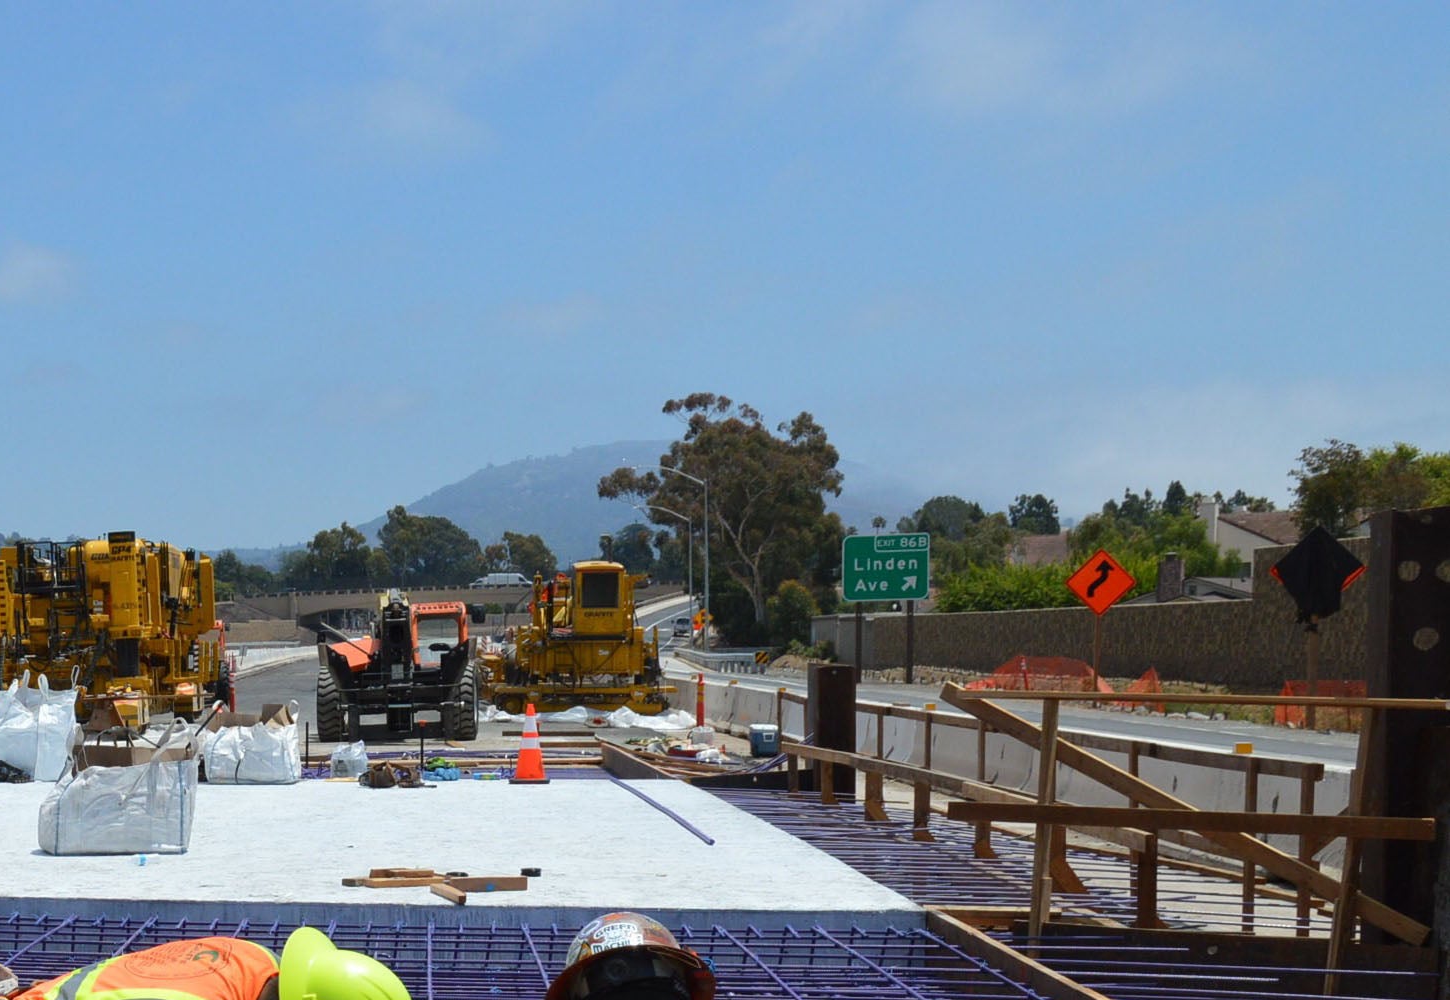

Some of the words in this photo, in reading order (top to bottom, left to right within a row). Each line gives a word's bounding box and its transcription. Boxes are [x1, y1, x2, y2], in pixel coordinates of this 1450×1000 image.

[877, 539, 896, 547] EXIT
[900, 537, 927, 548] 86B
[854, 558, 918, 571] Linden
[854, 579, 889, 592] Ave
